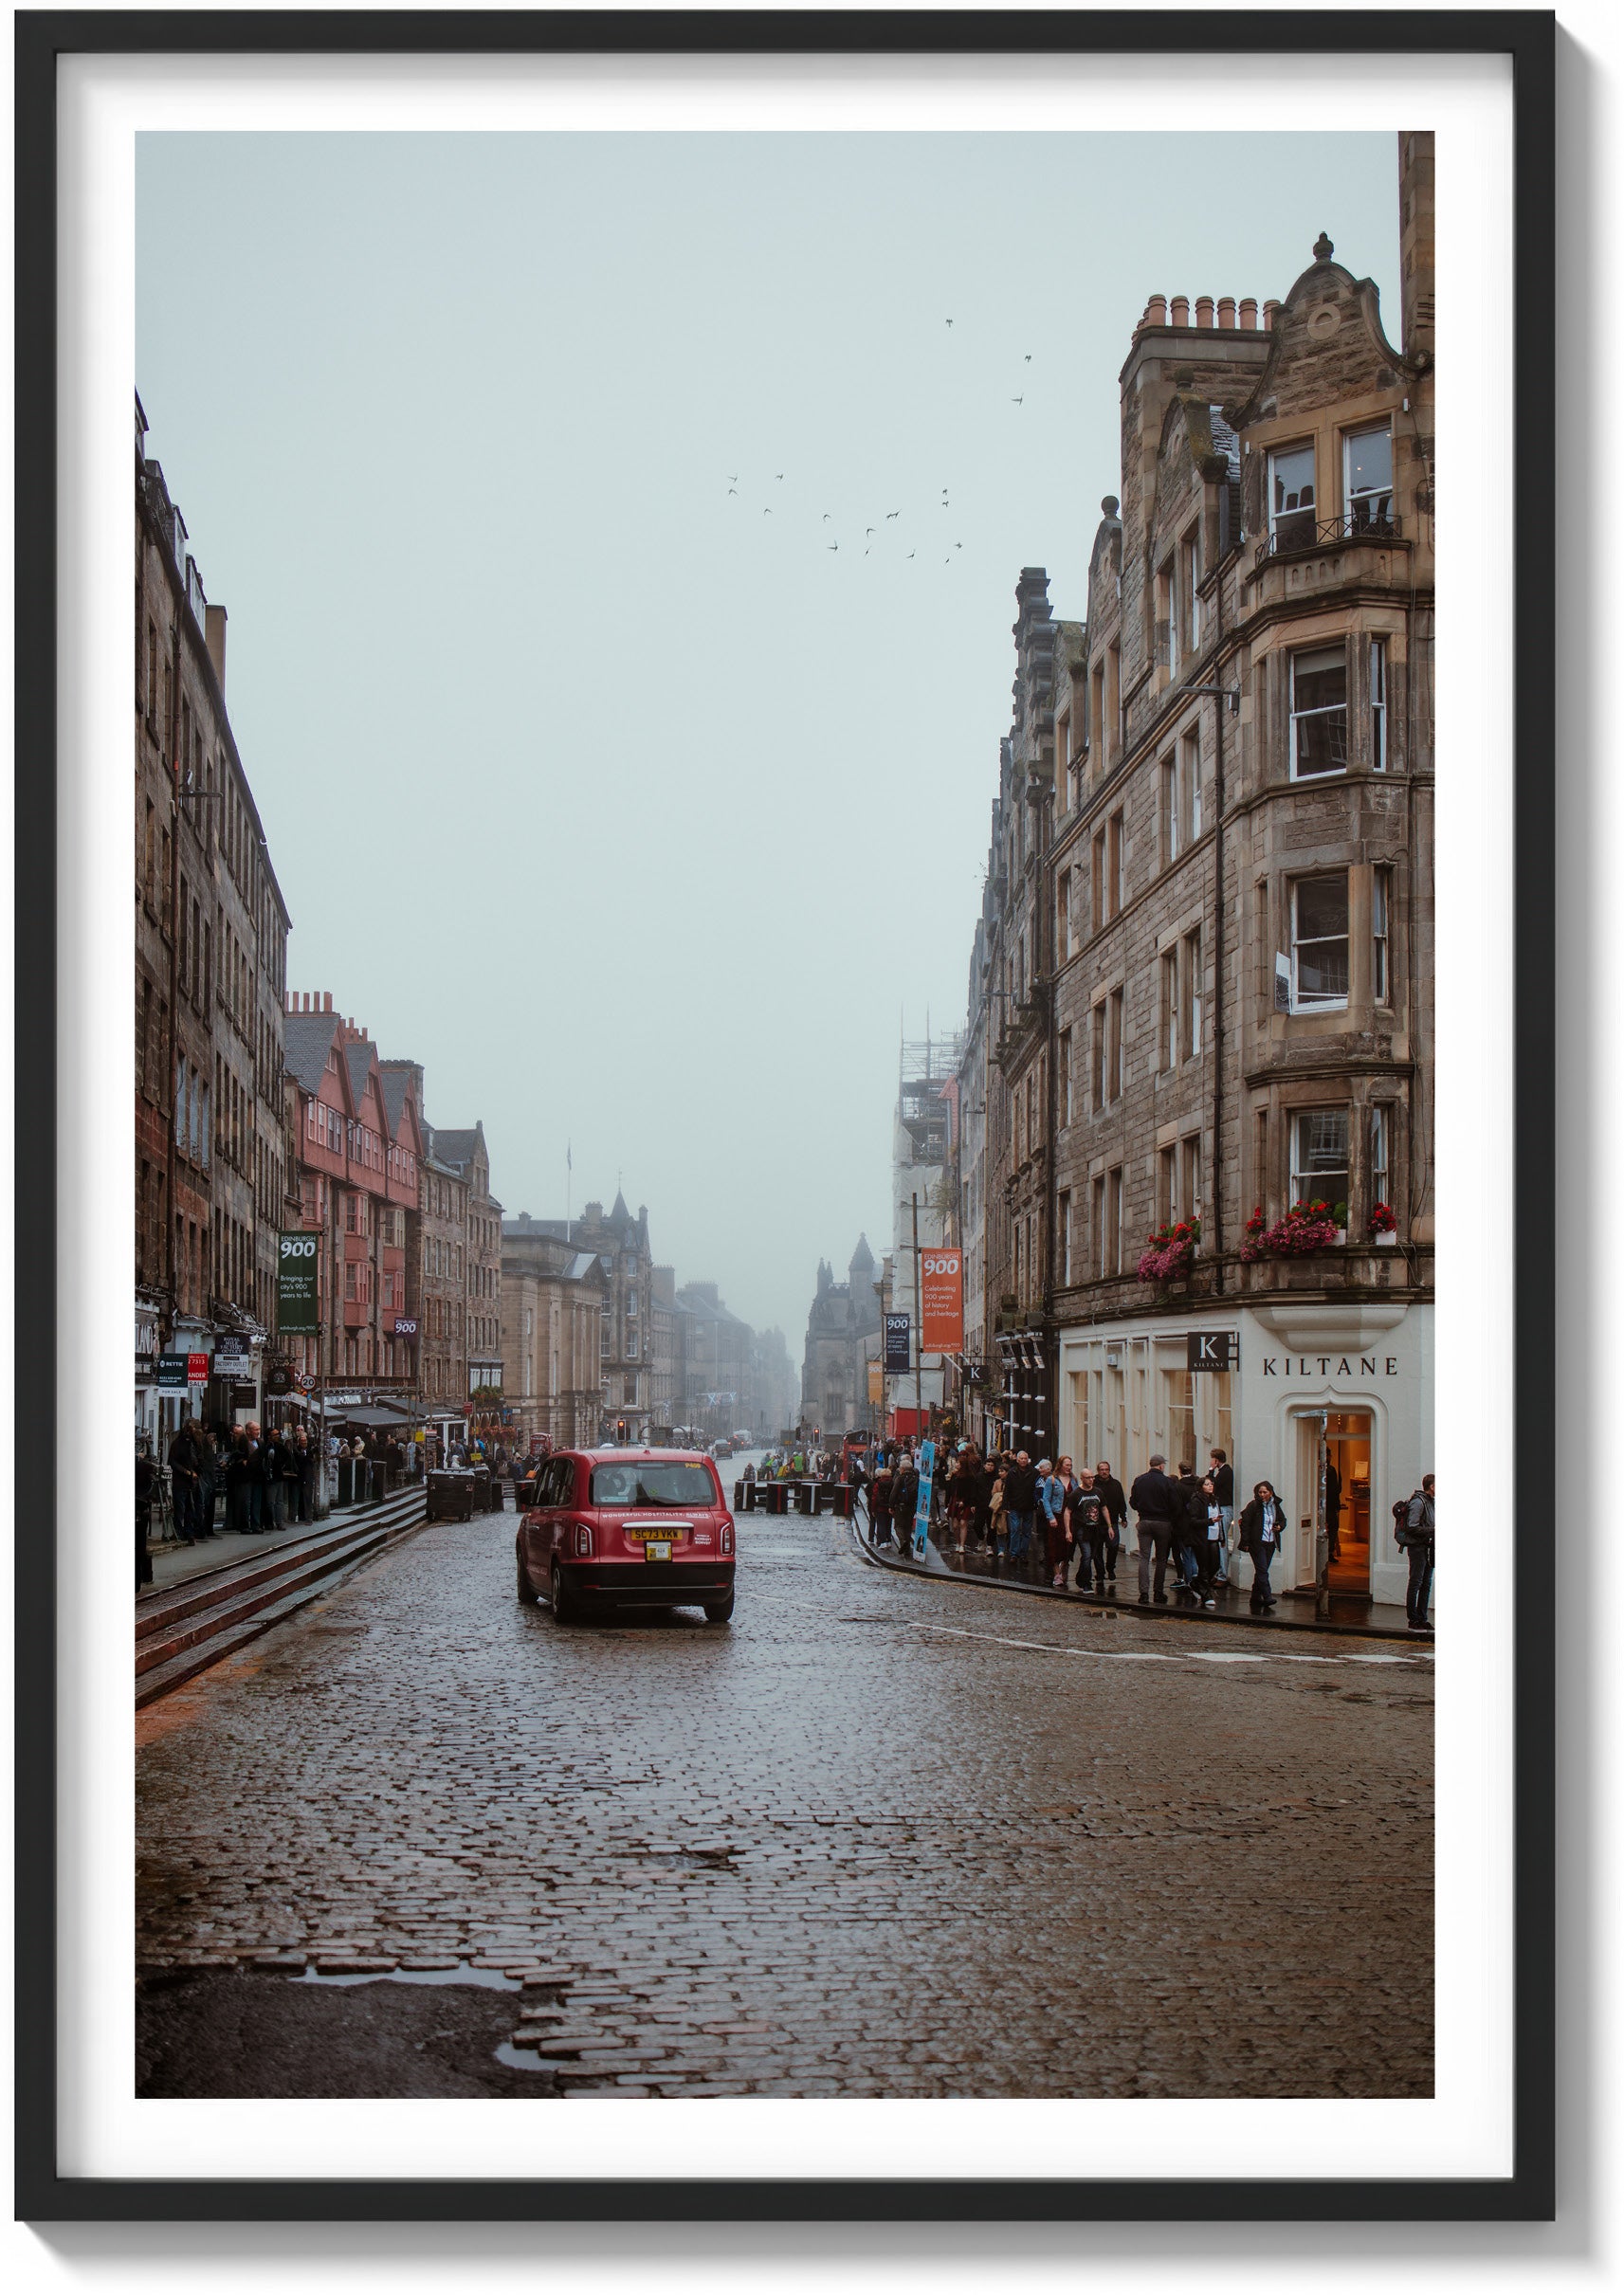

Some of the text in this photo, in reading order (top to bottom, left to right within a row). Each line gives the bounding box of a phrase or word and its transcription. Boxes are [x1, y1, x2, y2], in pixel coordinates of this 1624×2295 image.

[281, 1241, 316, 1259] 900
[924, 1259, 958, 1276] 900
[396, 1323, 416, 1333] 900
[887, 1320, 908, 1330] 900
[1200, 1336, 1218, 1358] K
[971, 1367, 980, 1379] K
[1263, 1357, 1398, 1375] KILTANE
[635, 1530, 678, 1538] SC73 VKW
